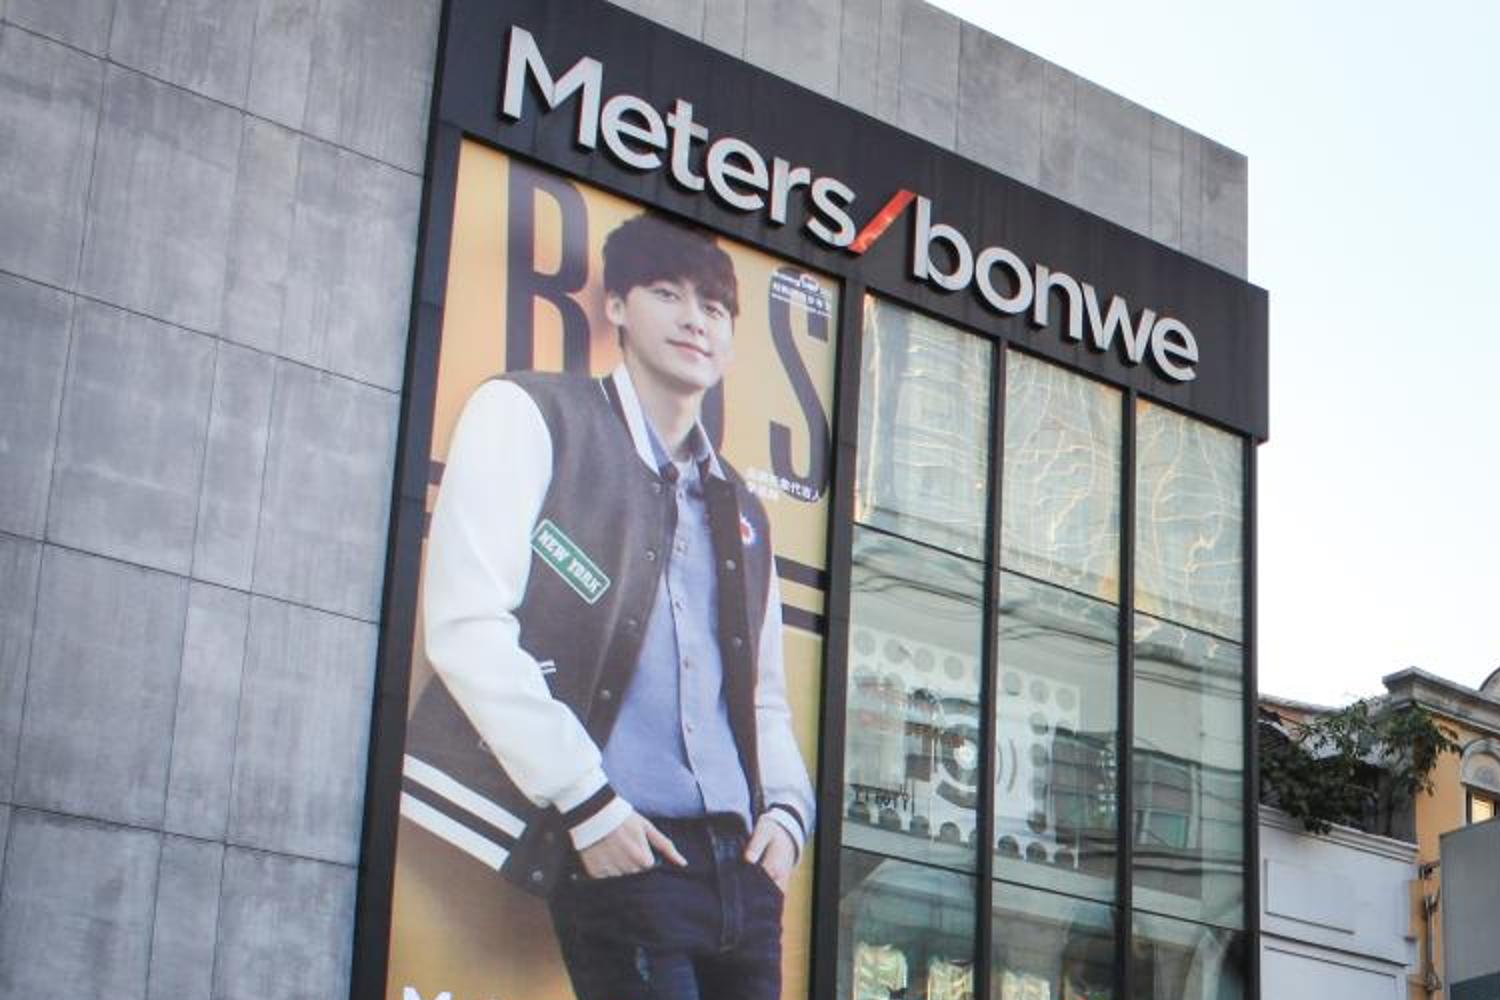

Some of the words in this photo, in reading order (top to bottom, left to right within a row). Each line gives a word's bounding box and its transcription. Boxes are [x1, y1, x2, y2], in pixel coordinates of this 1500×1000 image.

[503, 26, 1199, 383] Meters/bonwe
[538, 530, 570, 561] NEW
[566, 558, 602, 593] YORK
